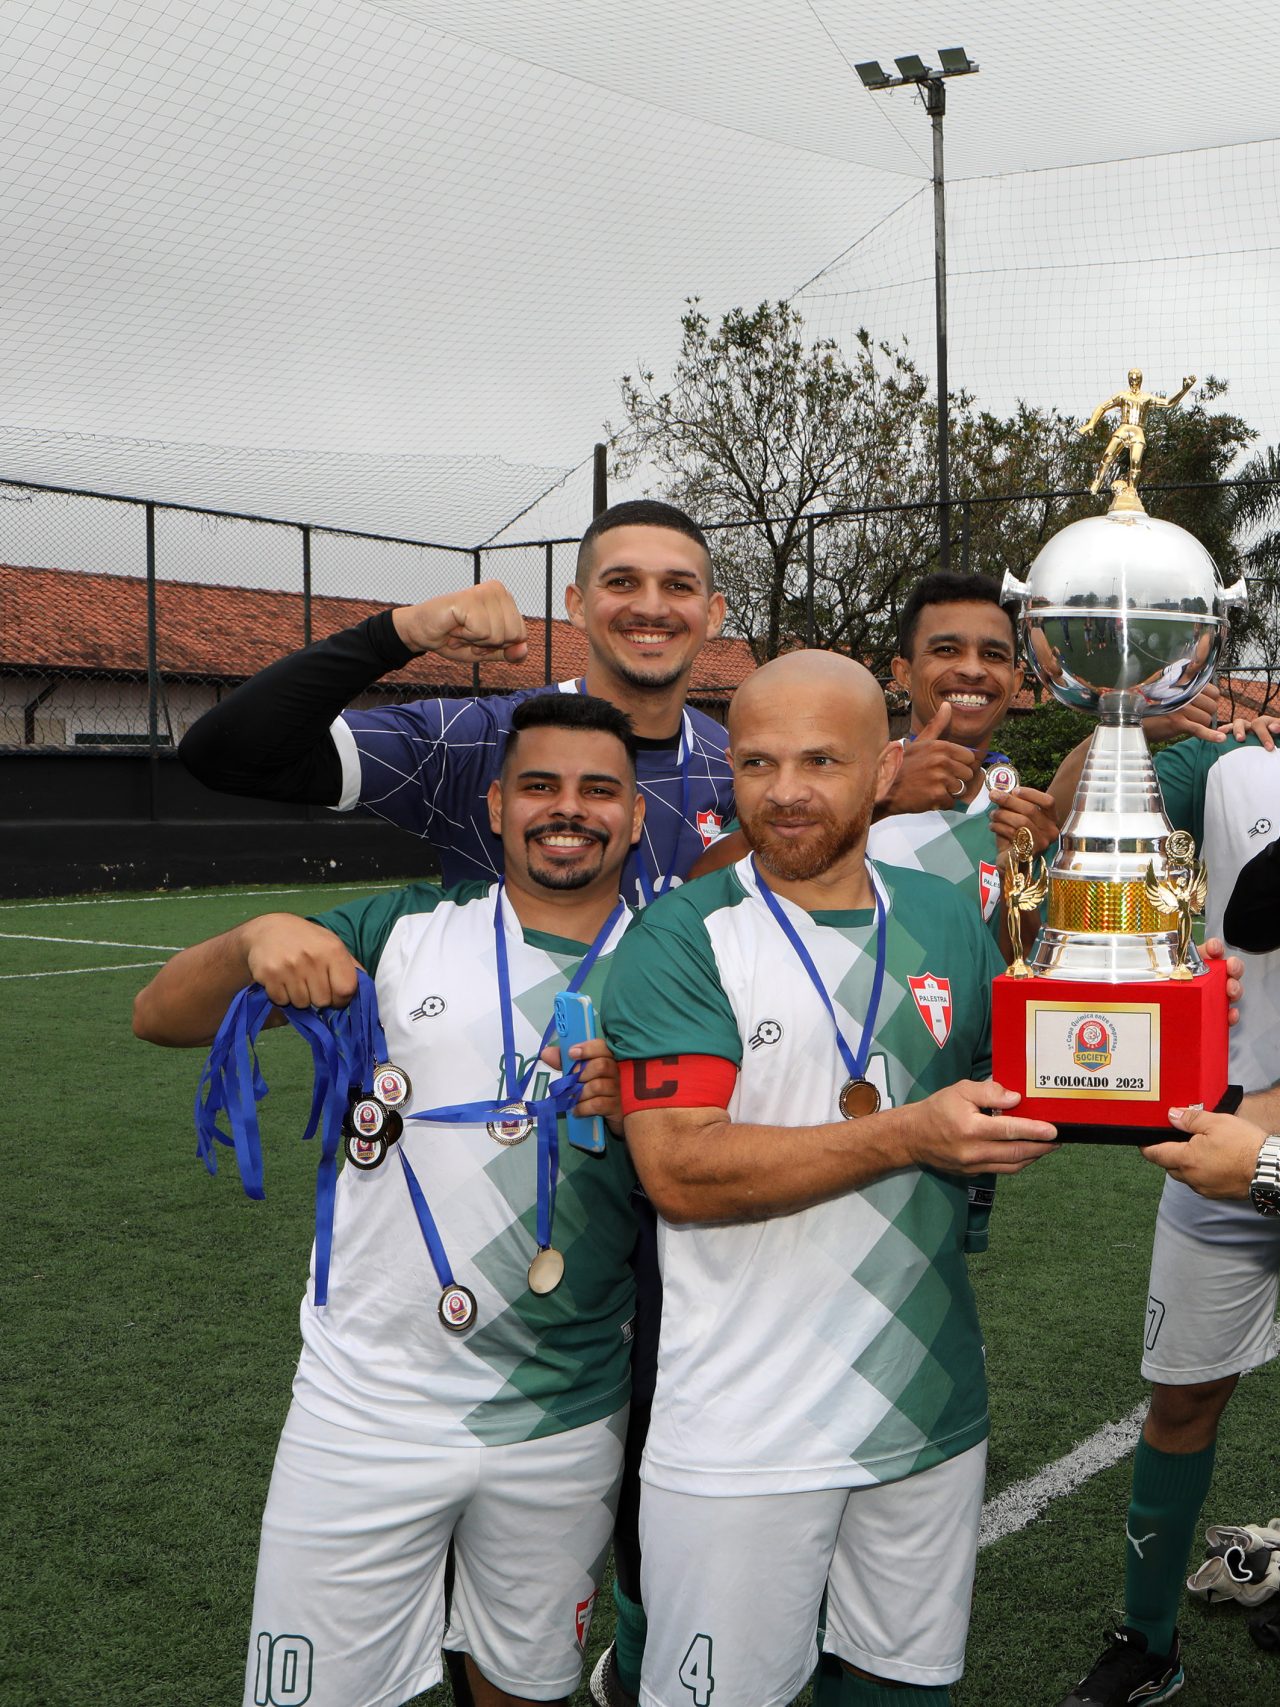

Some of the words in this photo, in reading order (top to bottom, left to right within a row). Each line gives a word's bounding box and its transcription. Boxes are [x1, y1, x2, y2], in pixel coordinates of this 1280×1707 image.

[918, 995, 948, 1003] PALESTRA
[1094, 1014, 1110, 1024] entre
[1076, 1053, 1109, 1062] SOCIETY
[1053, 1075, 1109, 1088] COLOCADO
[1115, 1077, 1144, 1089] 2023
[254, 1631, 314, 1707] 10
[678, 1632, 715, 1707] 4
